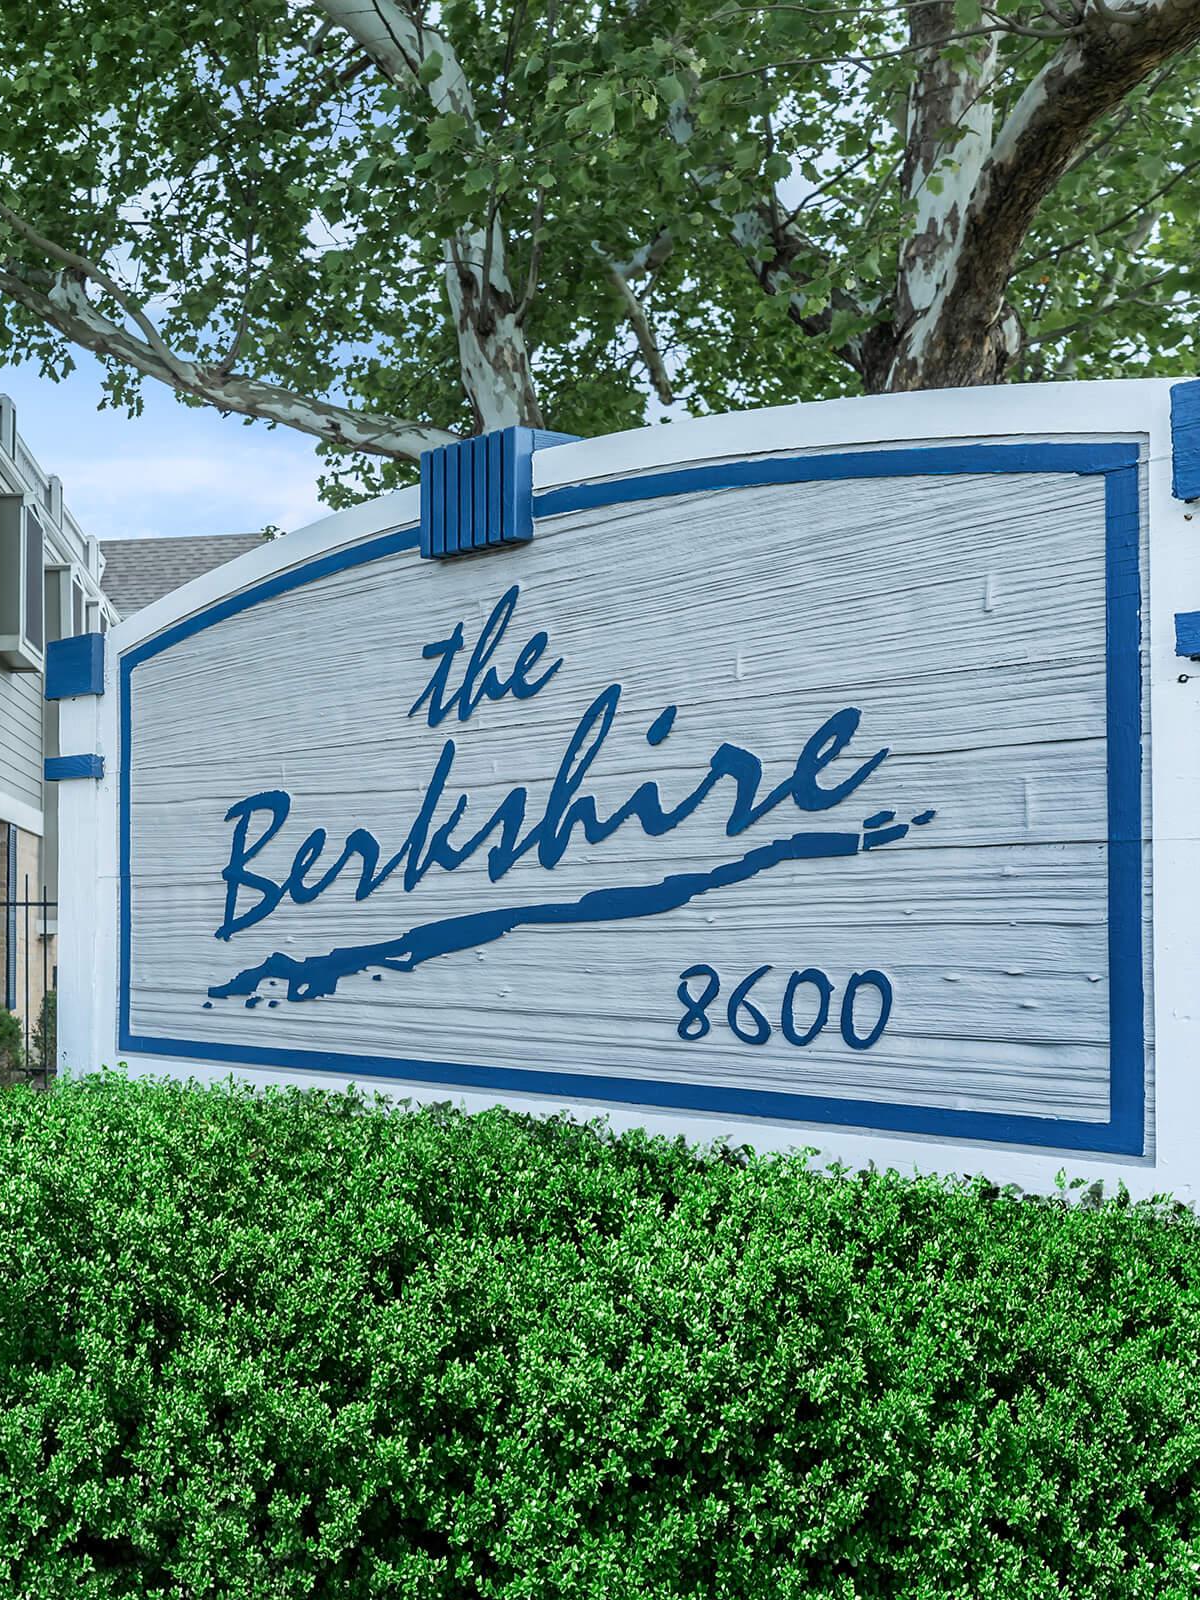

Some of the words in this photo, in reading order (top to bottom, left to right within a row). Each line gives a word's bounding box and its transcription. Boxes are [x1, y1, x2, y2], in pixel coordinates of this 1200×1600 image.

[408, 585, 563, 728] the
[214, 683, 889, 942] Berkshire
[676, 964, 893, 1051] 8600
